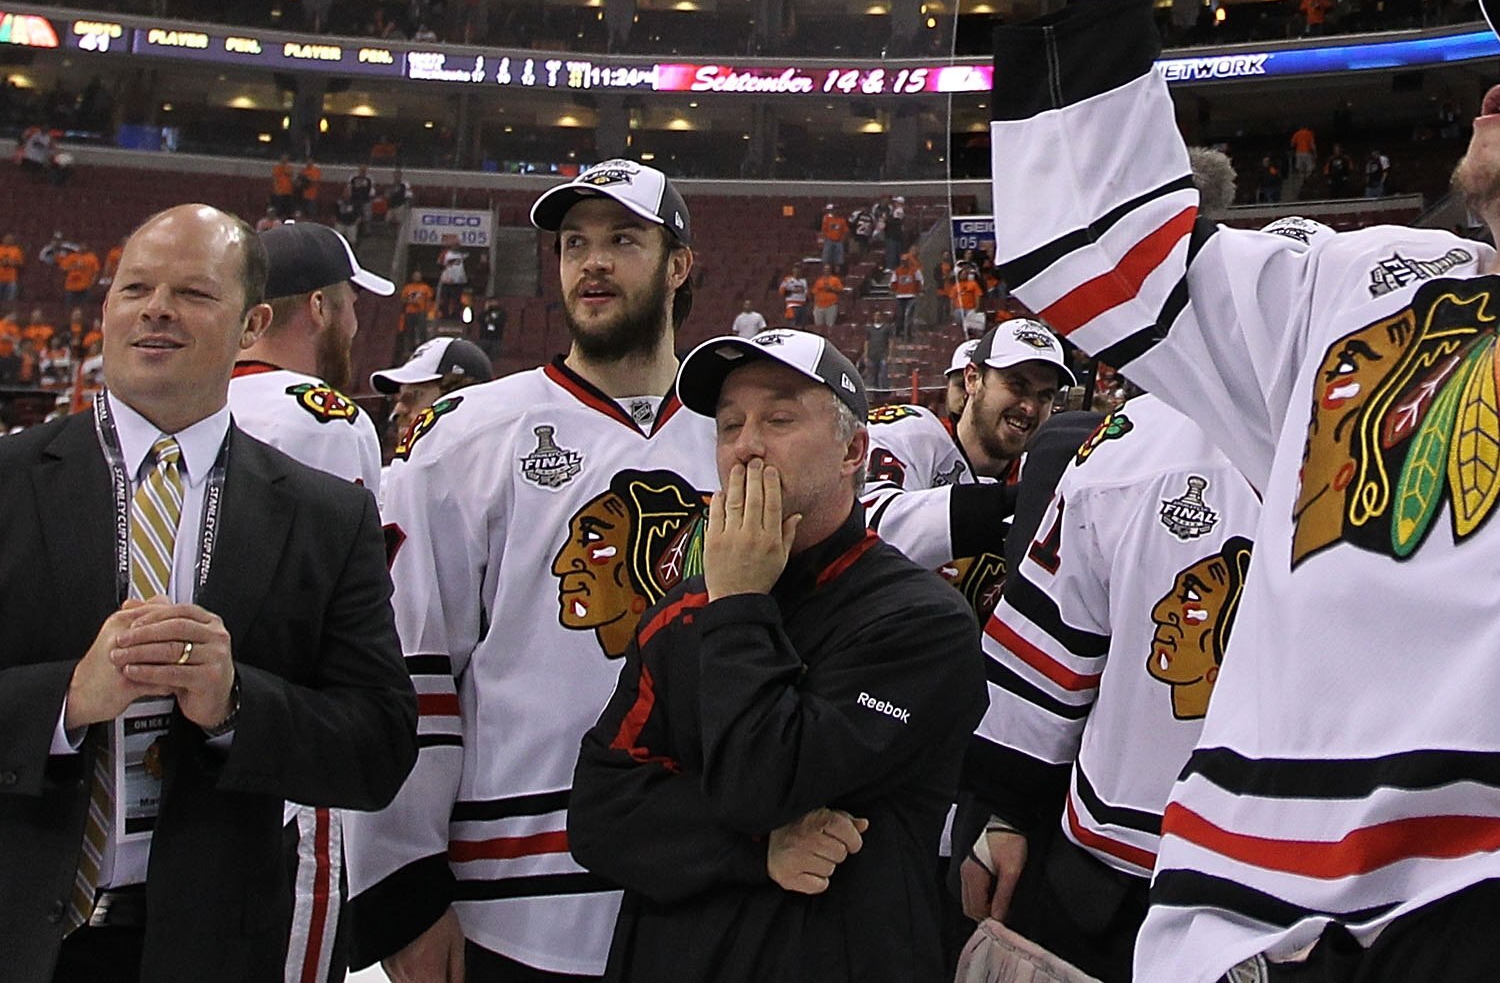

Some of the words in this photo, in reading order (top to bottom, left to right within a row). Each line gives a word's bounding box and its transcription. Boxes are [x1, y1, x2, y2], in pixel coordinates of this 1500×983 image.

[148, 28, 209, 49] PLAYER
[284, 42, 342, 60] PLAYER
[692, 65, 814, 93] September
[823, 69, 858, 93] 14
[861, 69, 886, 93] &
[893, 68, 929, 93] 15
[422, 214, 481, 227] GEICO
[414, 229, 439, 243] 106
[461, 231, 488, 245] 105
[524, 452, 580, 470] FINAL
[114, 466, 127, 515] STANLEY
[206, 486, 219, 532] STANLEY
[1163, 503, 1214, 524] FINAL
[118, 515, 128, 541] CUP
[203, 531, 213, 553] CUP
[119, 541, 128, 573] FINAL
[856, 691, 911, 724] Reebok
